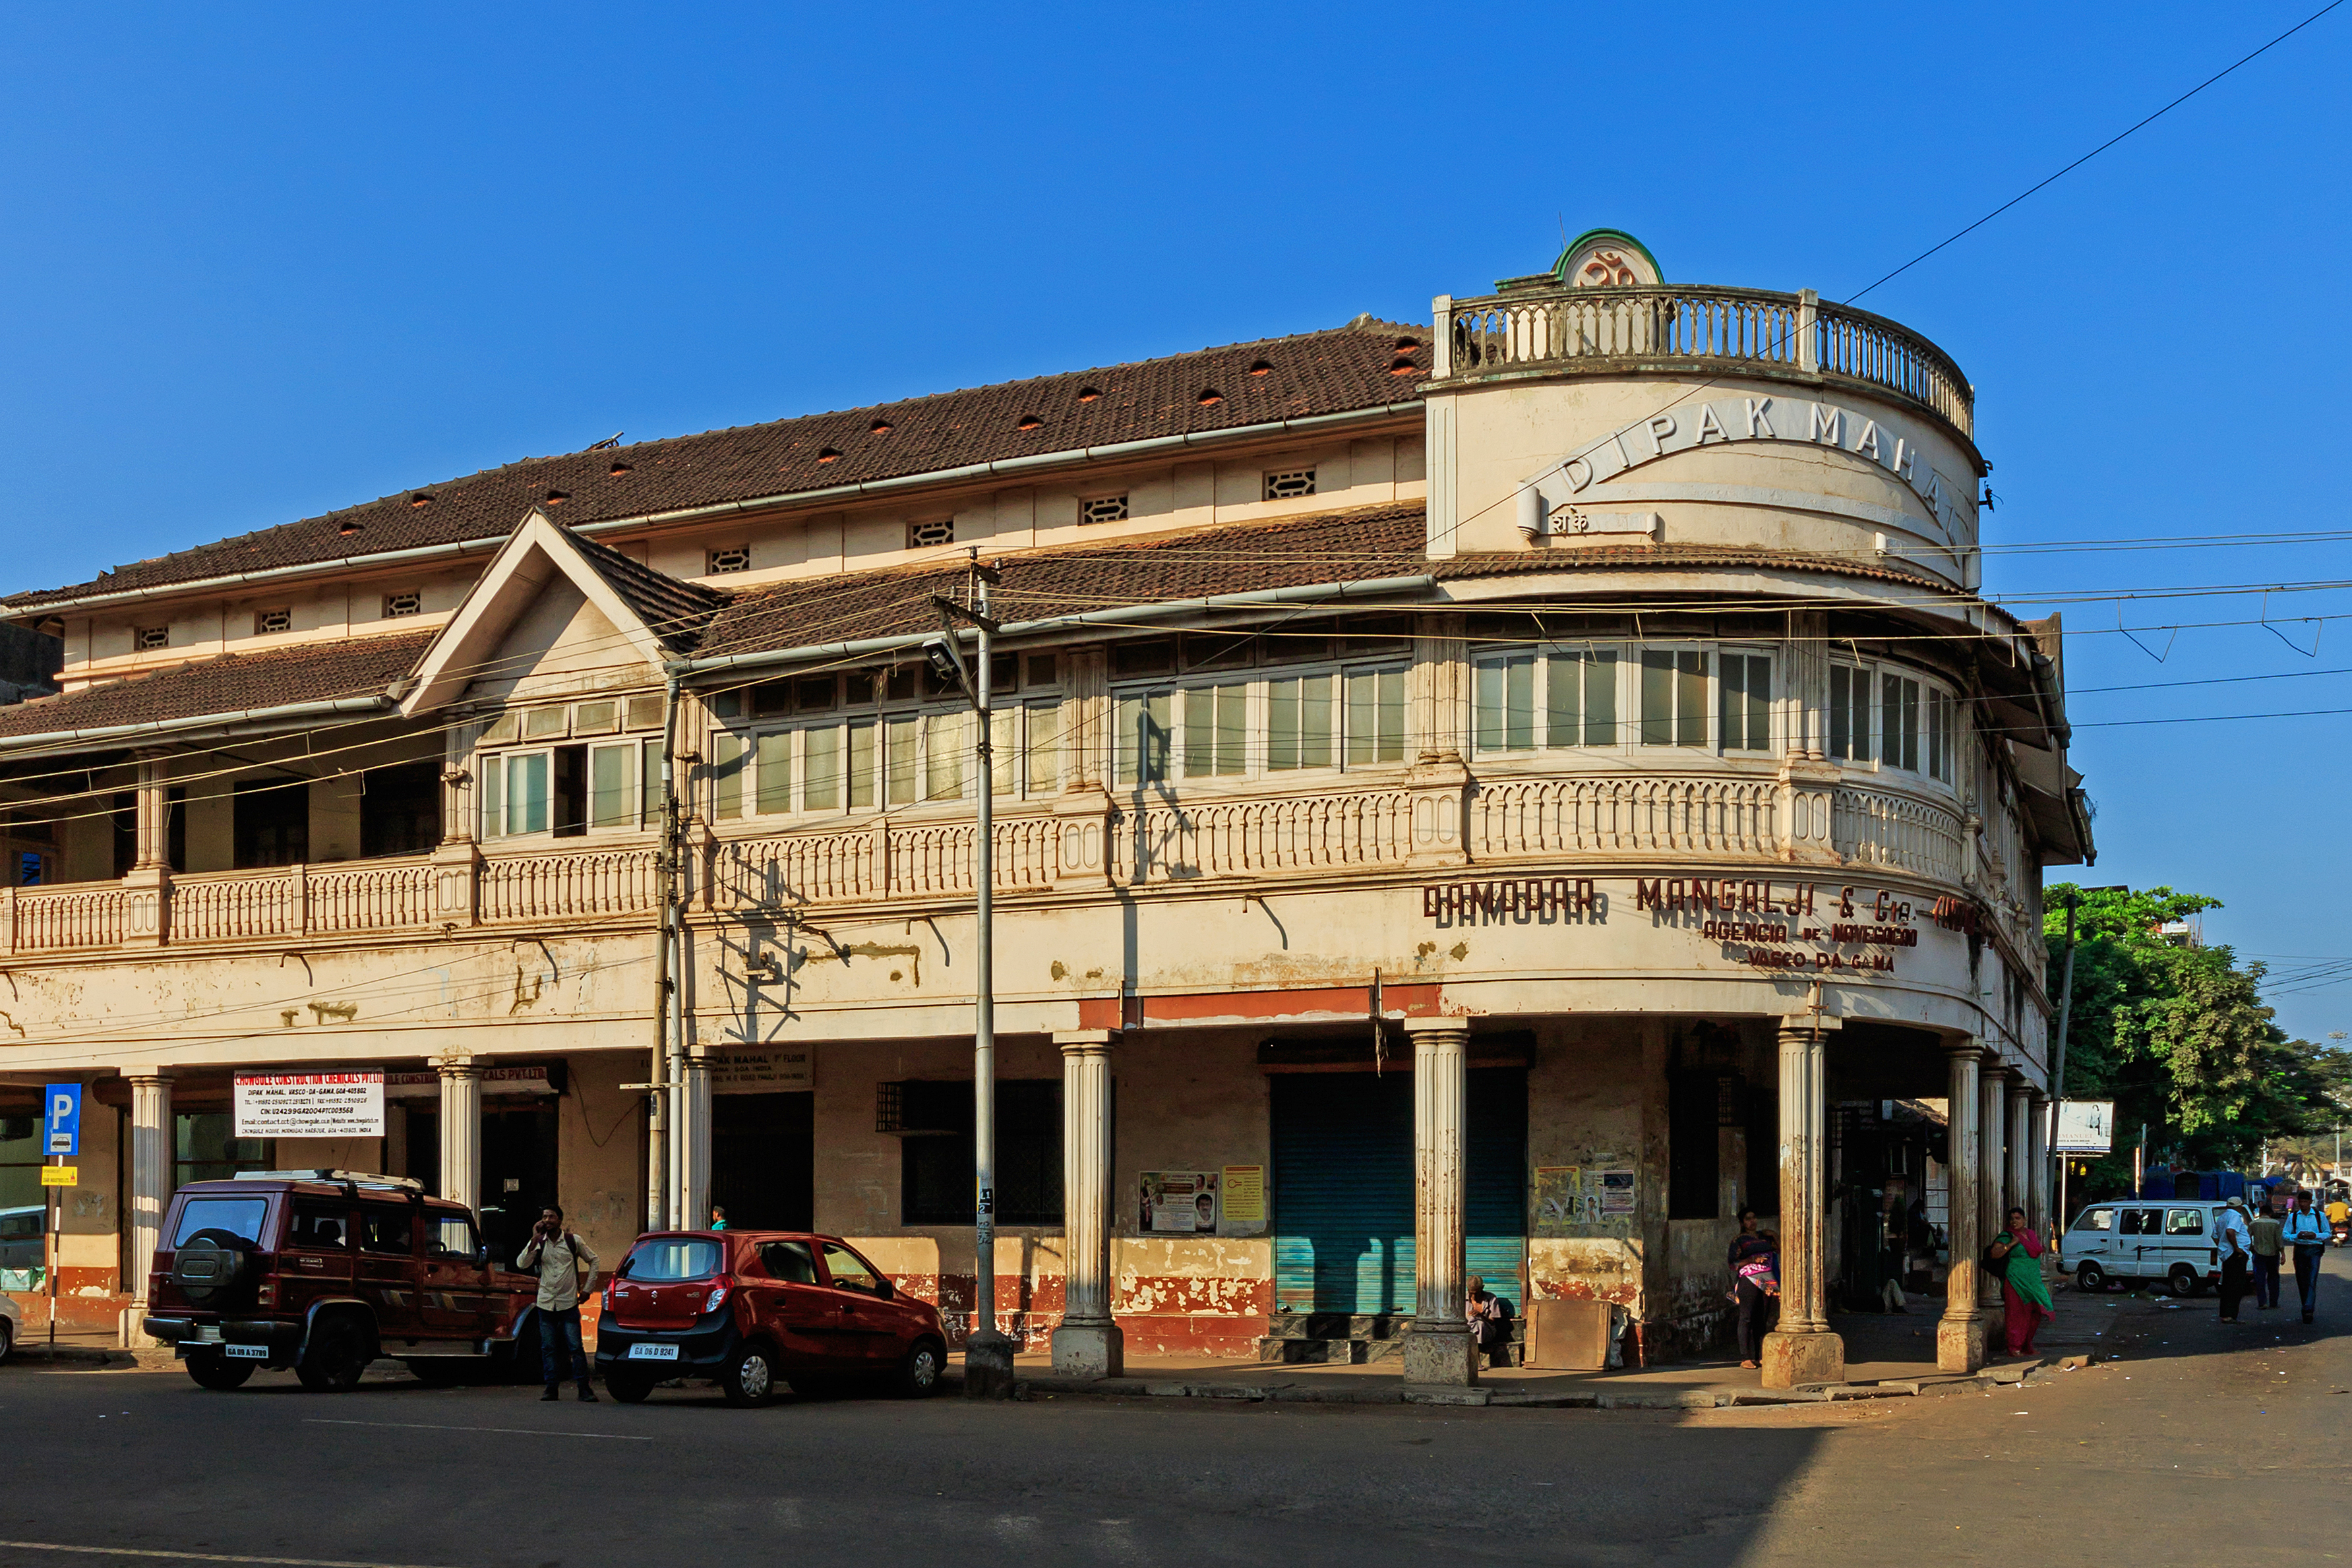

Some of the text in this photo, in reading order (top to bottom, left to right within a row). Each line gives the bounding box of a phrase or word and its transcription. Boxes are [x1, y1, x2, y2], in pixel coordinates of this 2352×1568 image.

[1557, 397, 1957, 549] DIPAK MAHAL
[1423, 876, 1594, 917] DAMODAR
[1637, 876, 1815, 917] MANGALJI
[1839, 885, 1855, 919] &
[1703, 920, 1788, 944] AGENCIA
[1802, 926, 1822, 942] DE
[1747, 950, 1895, 973] VASCO DA GAMA
[734, 1054, 769, 1064] MAHAL
[235, 1073, 272, 1086] CHOWGULE
[274, 1072, 323, 1085] CONSTRUCTION
[325, 1071, 360, 1085] CHEMICALS
[52, 1094, 73, 1130] P
[979, 1205, 985, 1214] 2
[644, 1347, 653, 1356] 06
[660, 1348, 674, 1356] 9241
